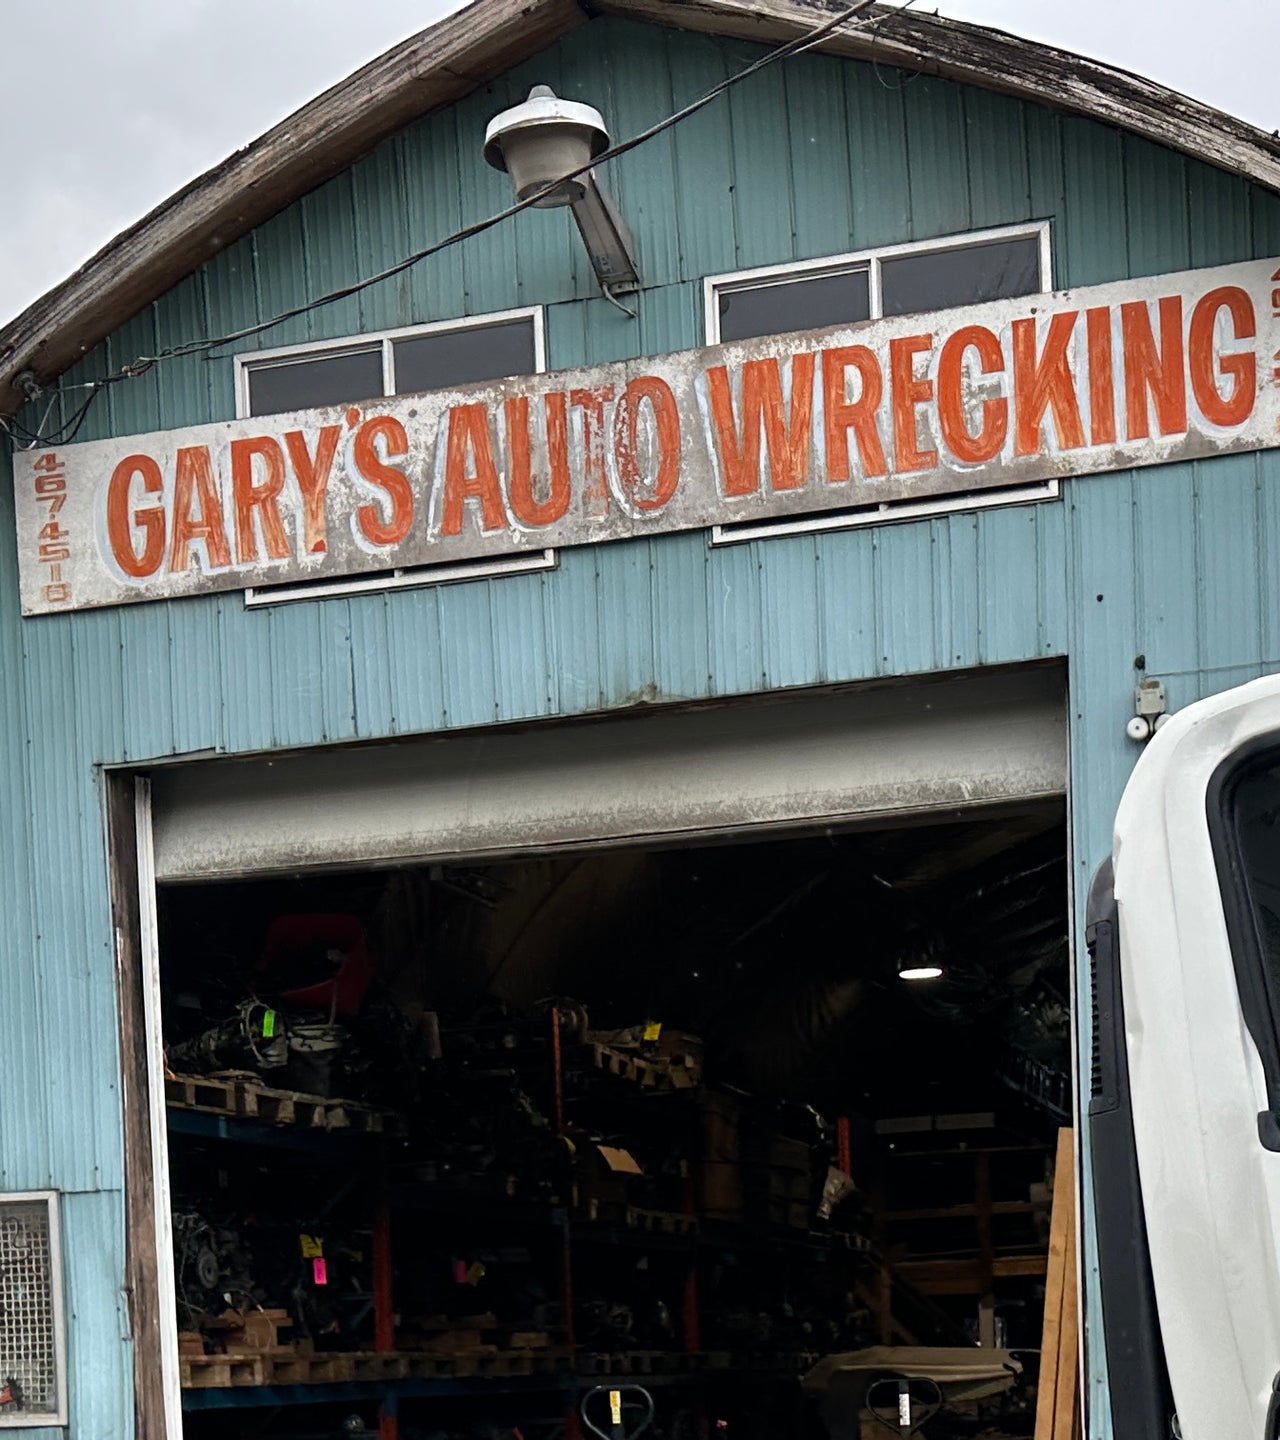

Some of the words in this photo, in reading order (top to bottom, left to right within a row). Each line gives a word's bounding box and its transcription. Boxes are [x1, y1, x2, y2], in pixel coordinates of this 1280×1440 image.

[107, 407, 414, 578] GARY'S
[441, 375, 682, 537] AUTO
[707, 285, 1257, 498] WRECKING
